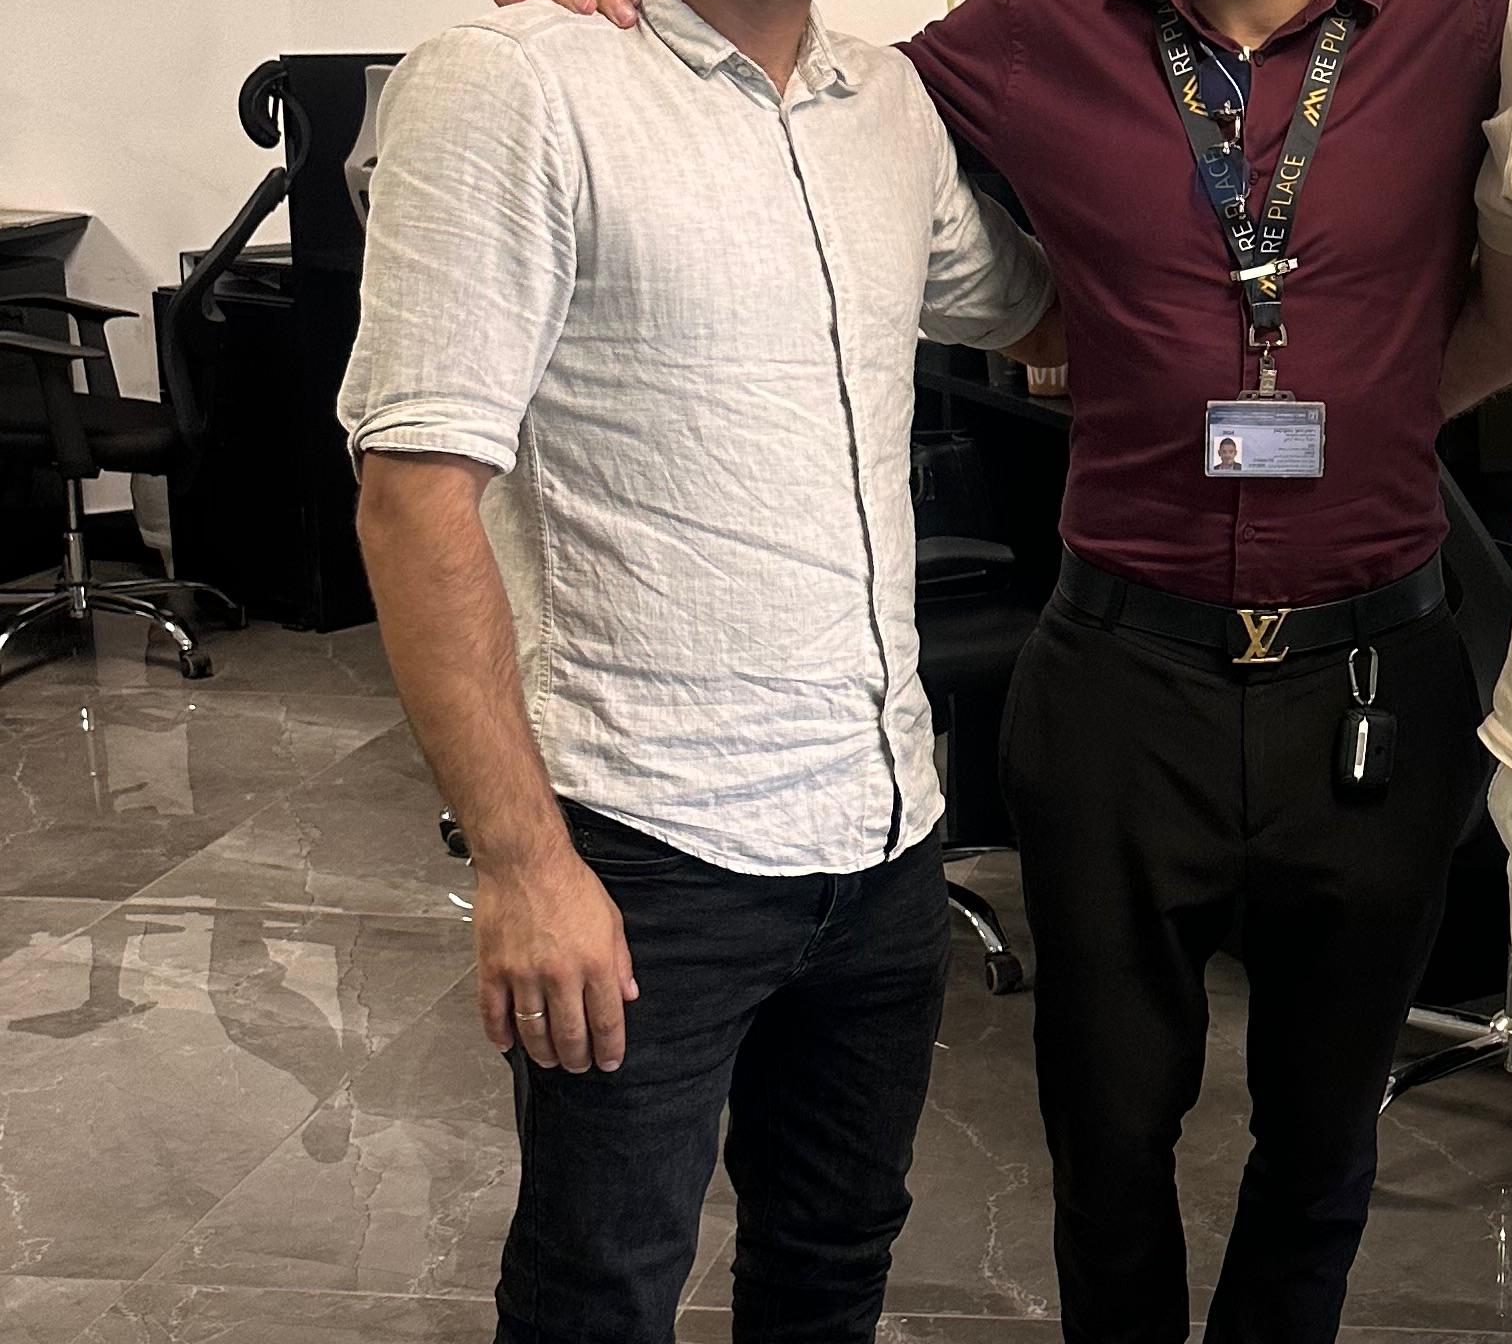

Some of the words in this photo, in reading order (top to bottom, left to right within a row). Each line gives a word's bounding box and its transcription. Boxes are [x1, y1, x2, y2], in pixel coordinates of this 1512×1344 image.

[1167, 43, 1194, 77] RE
[1311, 55, 1337, 84] RE
[1267, 153, 1306, 221] PLACE
[1231, 220, 1256, 252] RE
[1260, 226, 1285, 253] RE
